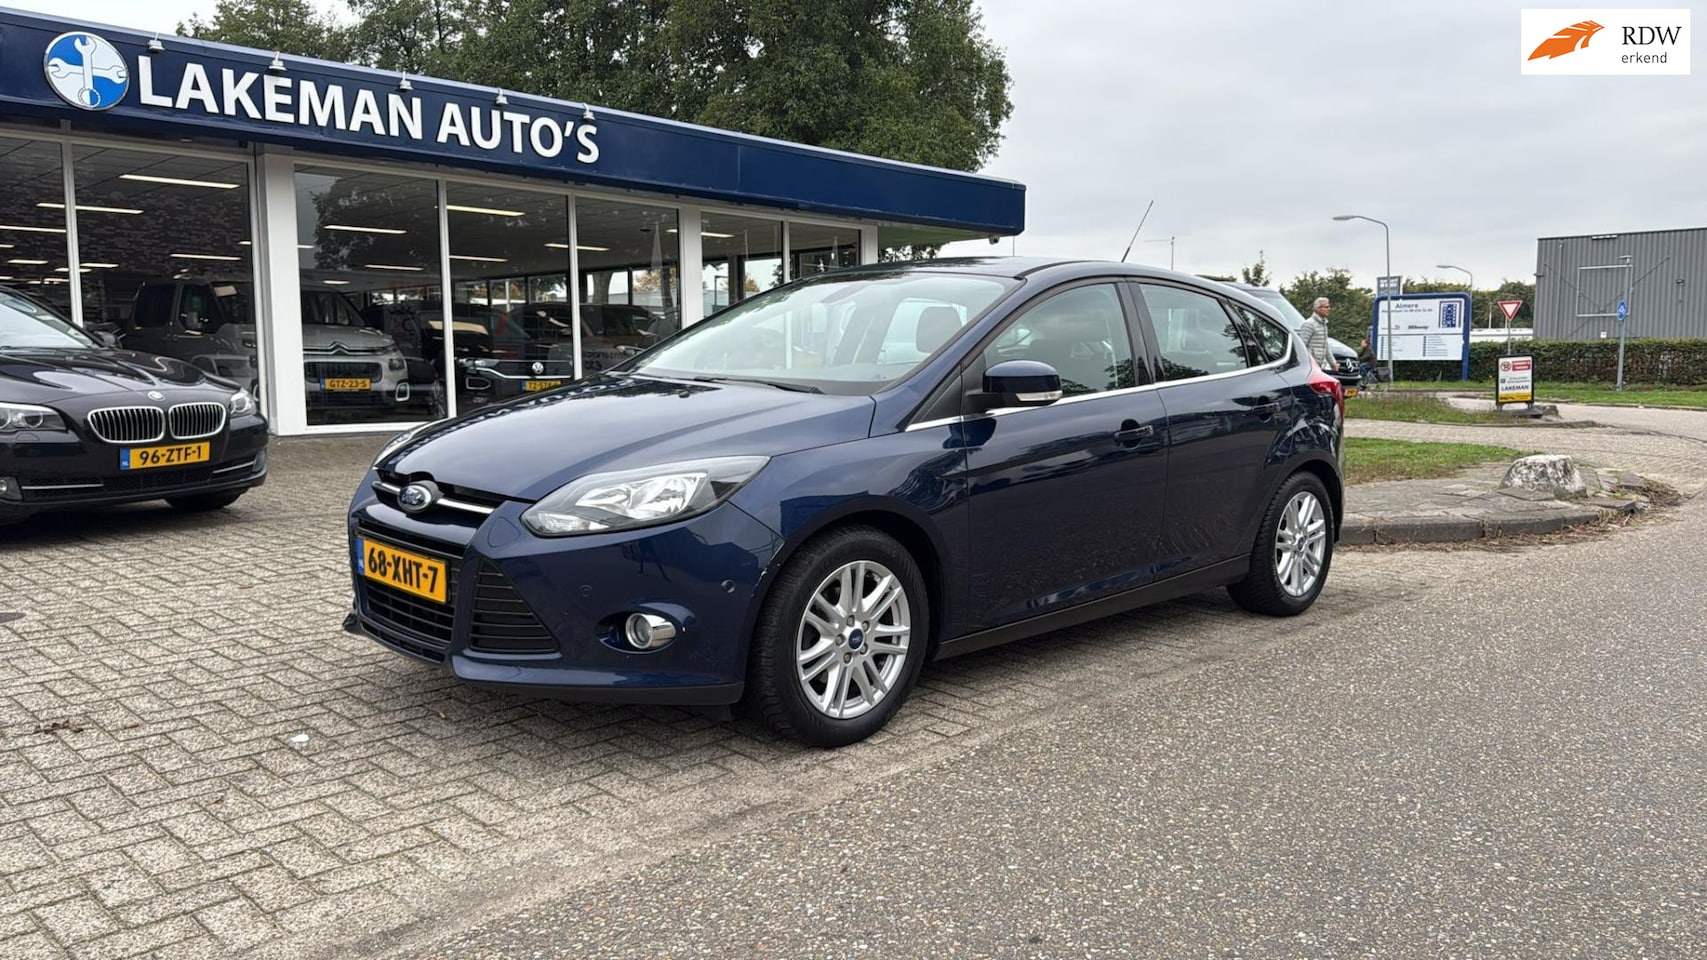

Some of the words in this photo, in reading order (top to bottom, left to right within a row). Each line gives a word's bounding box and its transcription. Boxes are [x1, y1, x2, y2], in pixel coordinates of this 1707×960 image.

[137, 55, 423, 140] LAKEMAN
[436, 103, 600, 164] AUTO'S
[1501, 384, 1530, 392] LAKEMAN
[139, 445, 202, 465] 96-ZTF-1
[368, 546, 439, 594] 68-XHT-7
